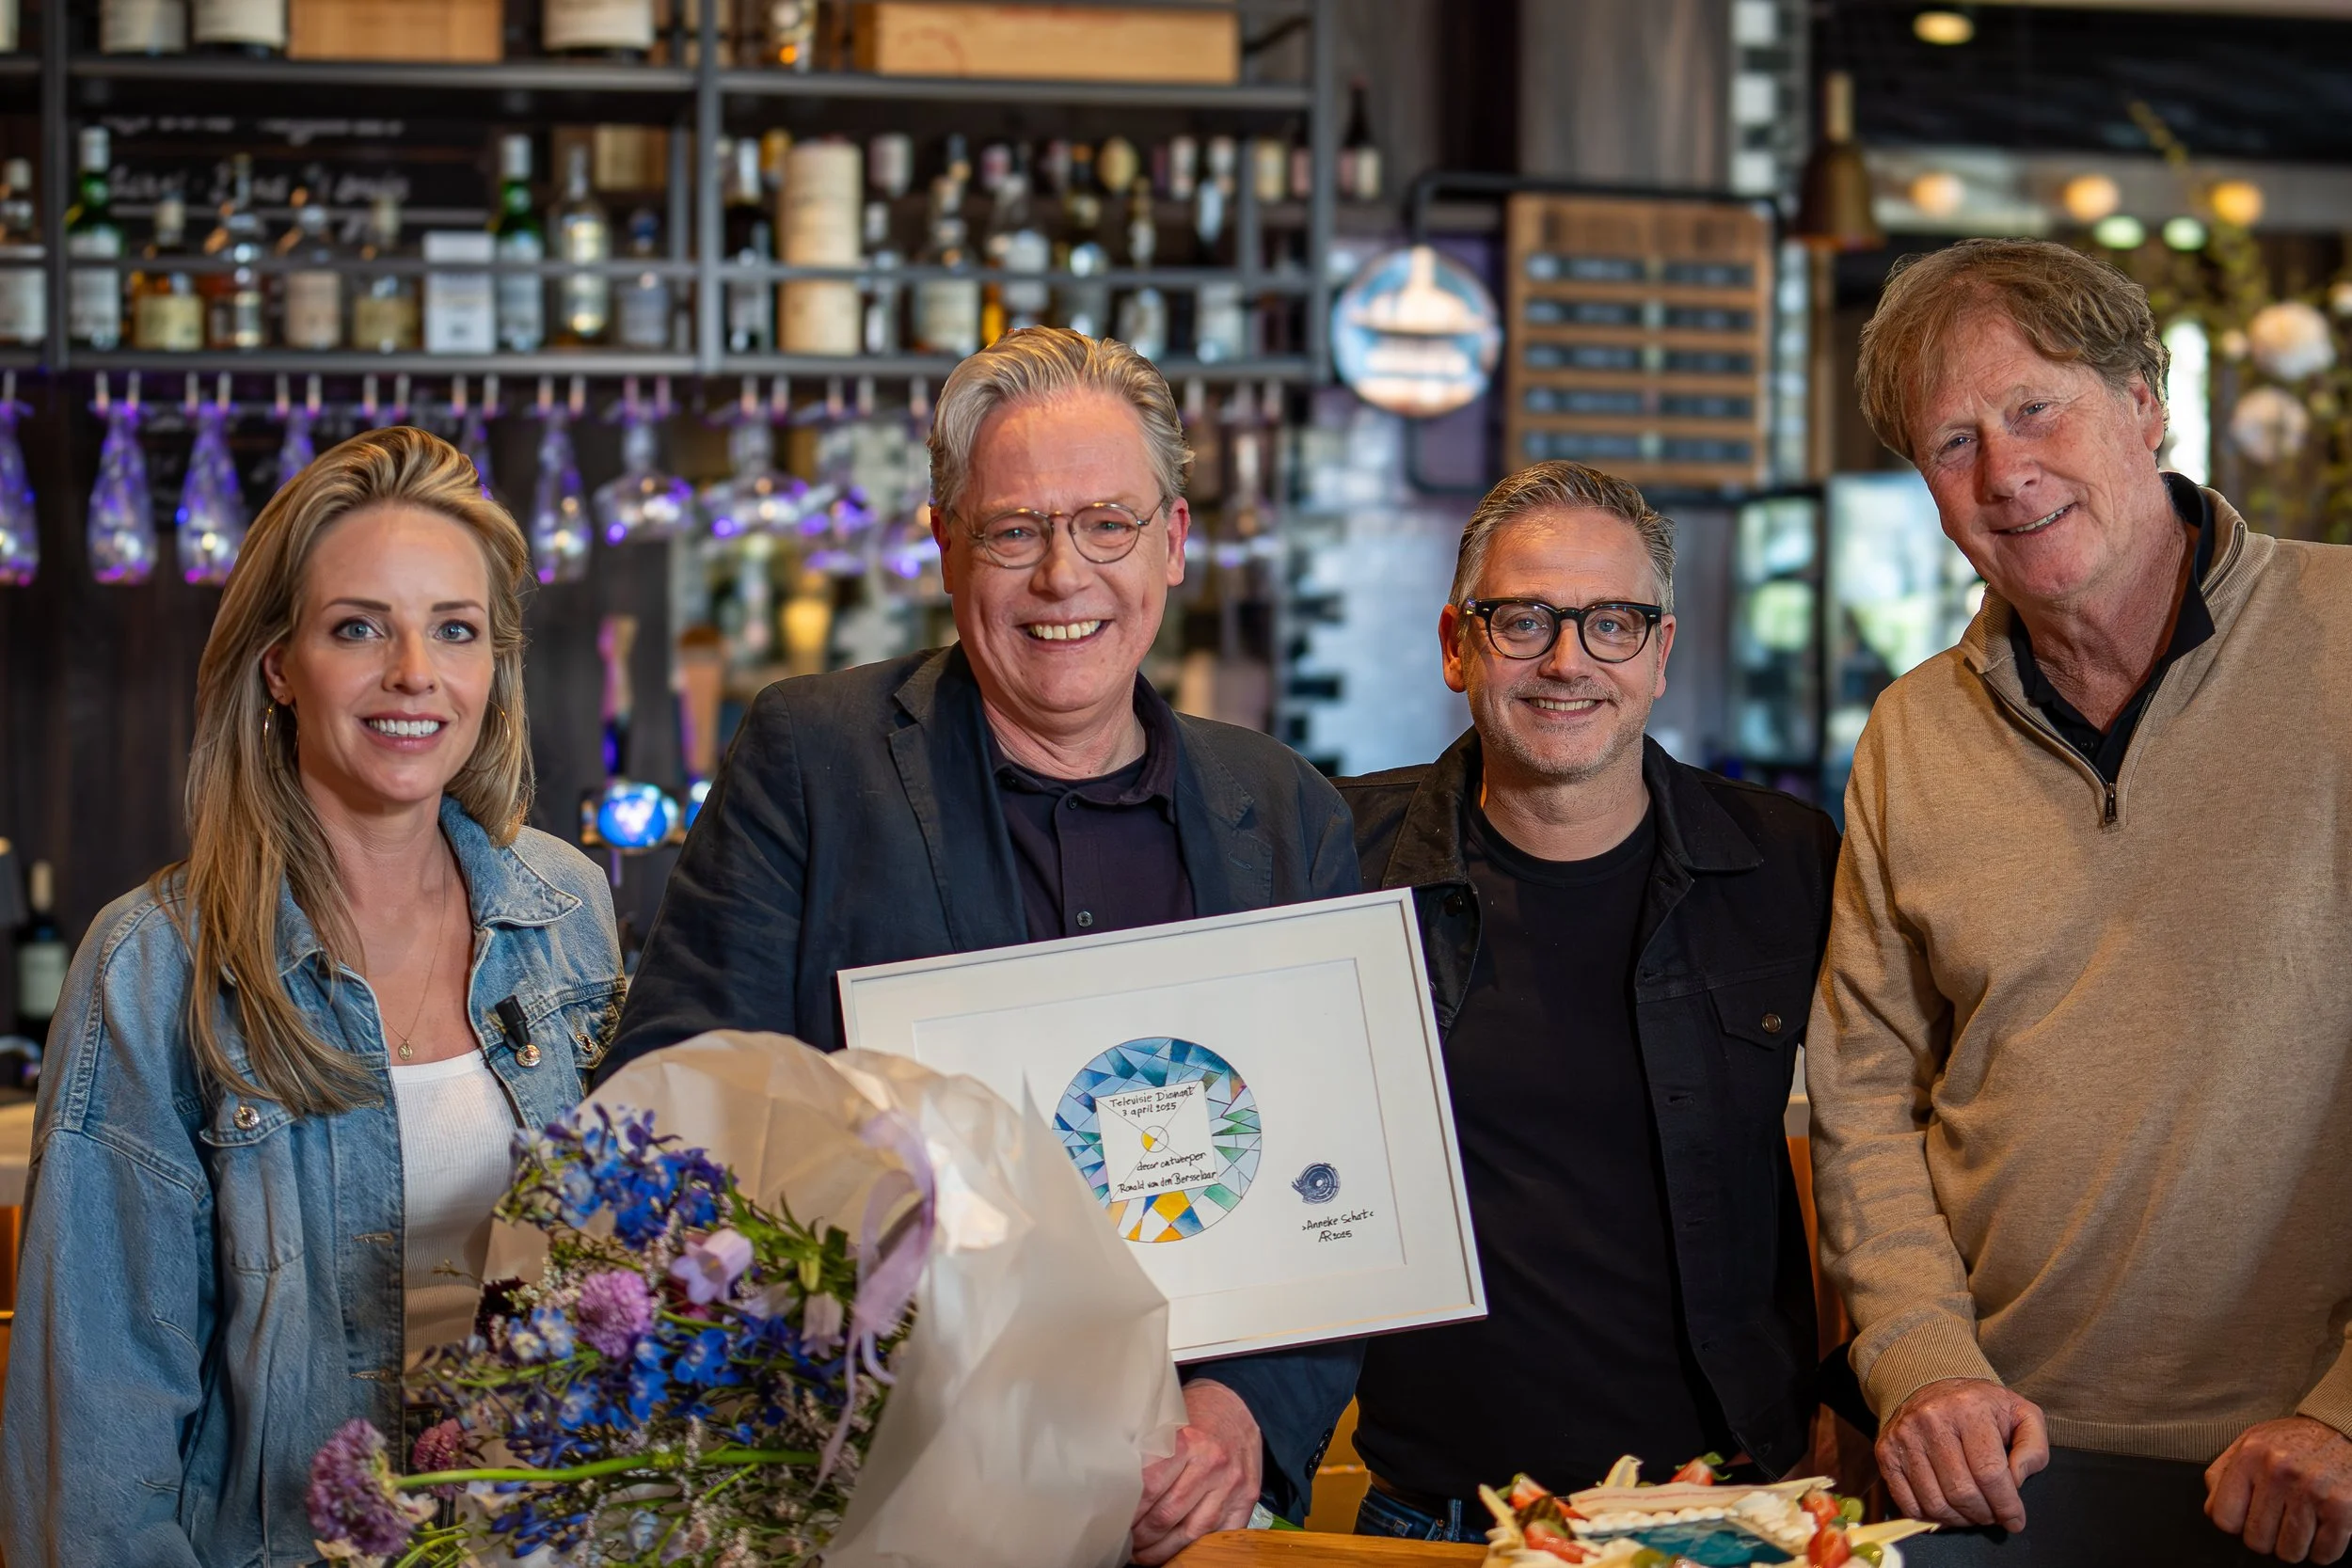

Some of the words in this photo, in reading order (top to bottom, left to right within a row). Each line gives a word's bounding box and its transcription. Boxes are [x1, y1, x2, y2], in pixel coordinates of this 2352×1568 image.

[1109, 1093, 1152, 1107] Televisie
[1155, 1085, 1195, 1102] Diamant
[1131, 1104, 1153, 1117] april
[1155, 1101, 1177, 1113] 2025
[1136, 1161, 1159, 1171] decor
[1117, 1180, 1144, 1193] Ronald
[1160, 1177, 1173, 1187] den
